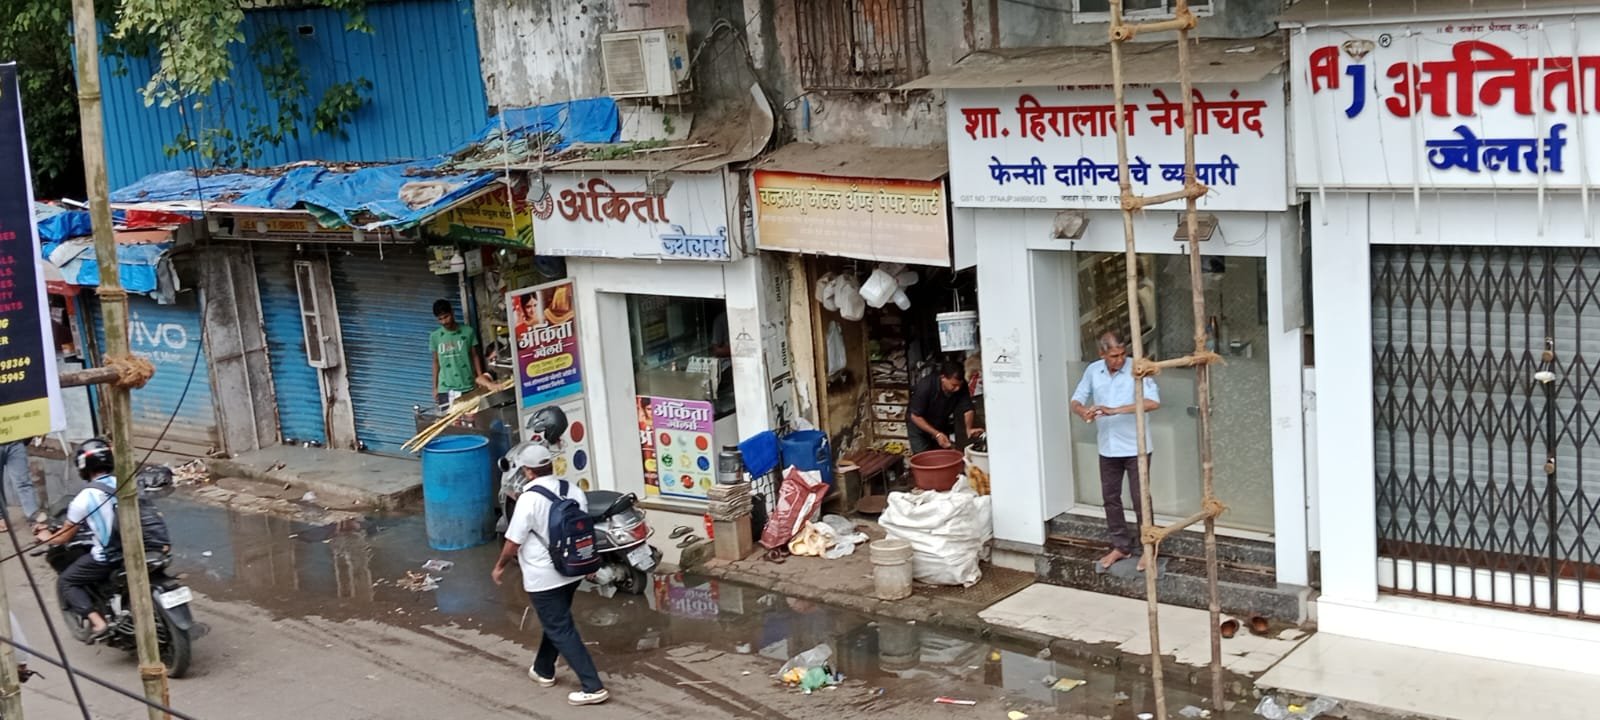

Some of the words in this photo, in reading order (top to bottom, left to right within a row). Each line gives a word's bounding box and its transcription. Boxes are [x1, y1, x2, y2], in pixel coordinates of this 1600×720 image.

[1385, 40, 1600, 118] अनिता
[961, 107, 1010, 140] शा.
[1016, 94, 1139, 142] हिरालाल
[1425, 123, 1567, 174] ज्वेलर्स
[989, 156, 1047, 186] फेन्सी
[1054, 156, 1151, 186] दागिन्यचे
[1159, 154, 1239, 186] व्यपारी
[557, 178, 670, 224] अंकिता
[878, 188, 907, 214] पेपर
[518, 319, 573, 349] अंकिता
[654, 401, 709, 422] अंकिता
